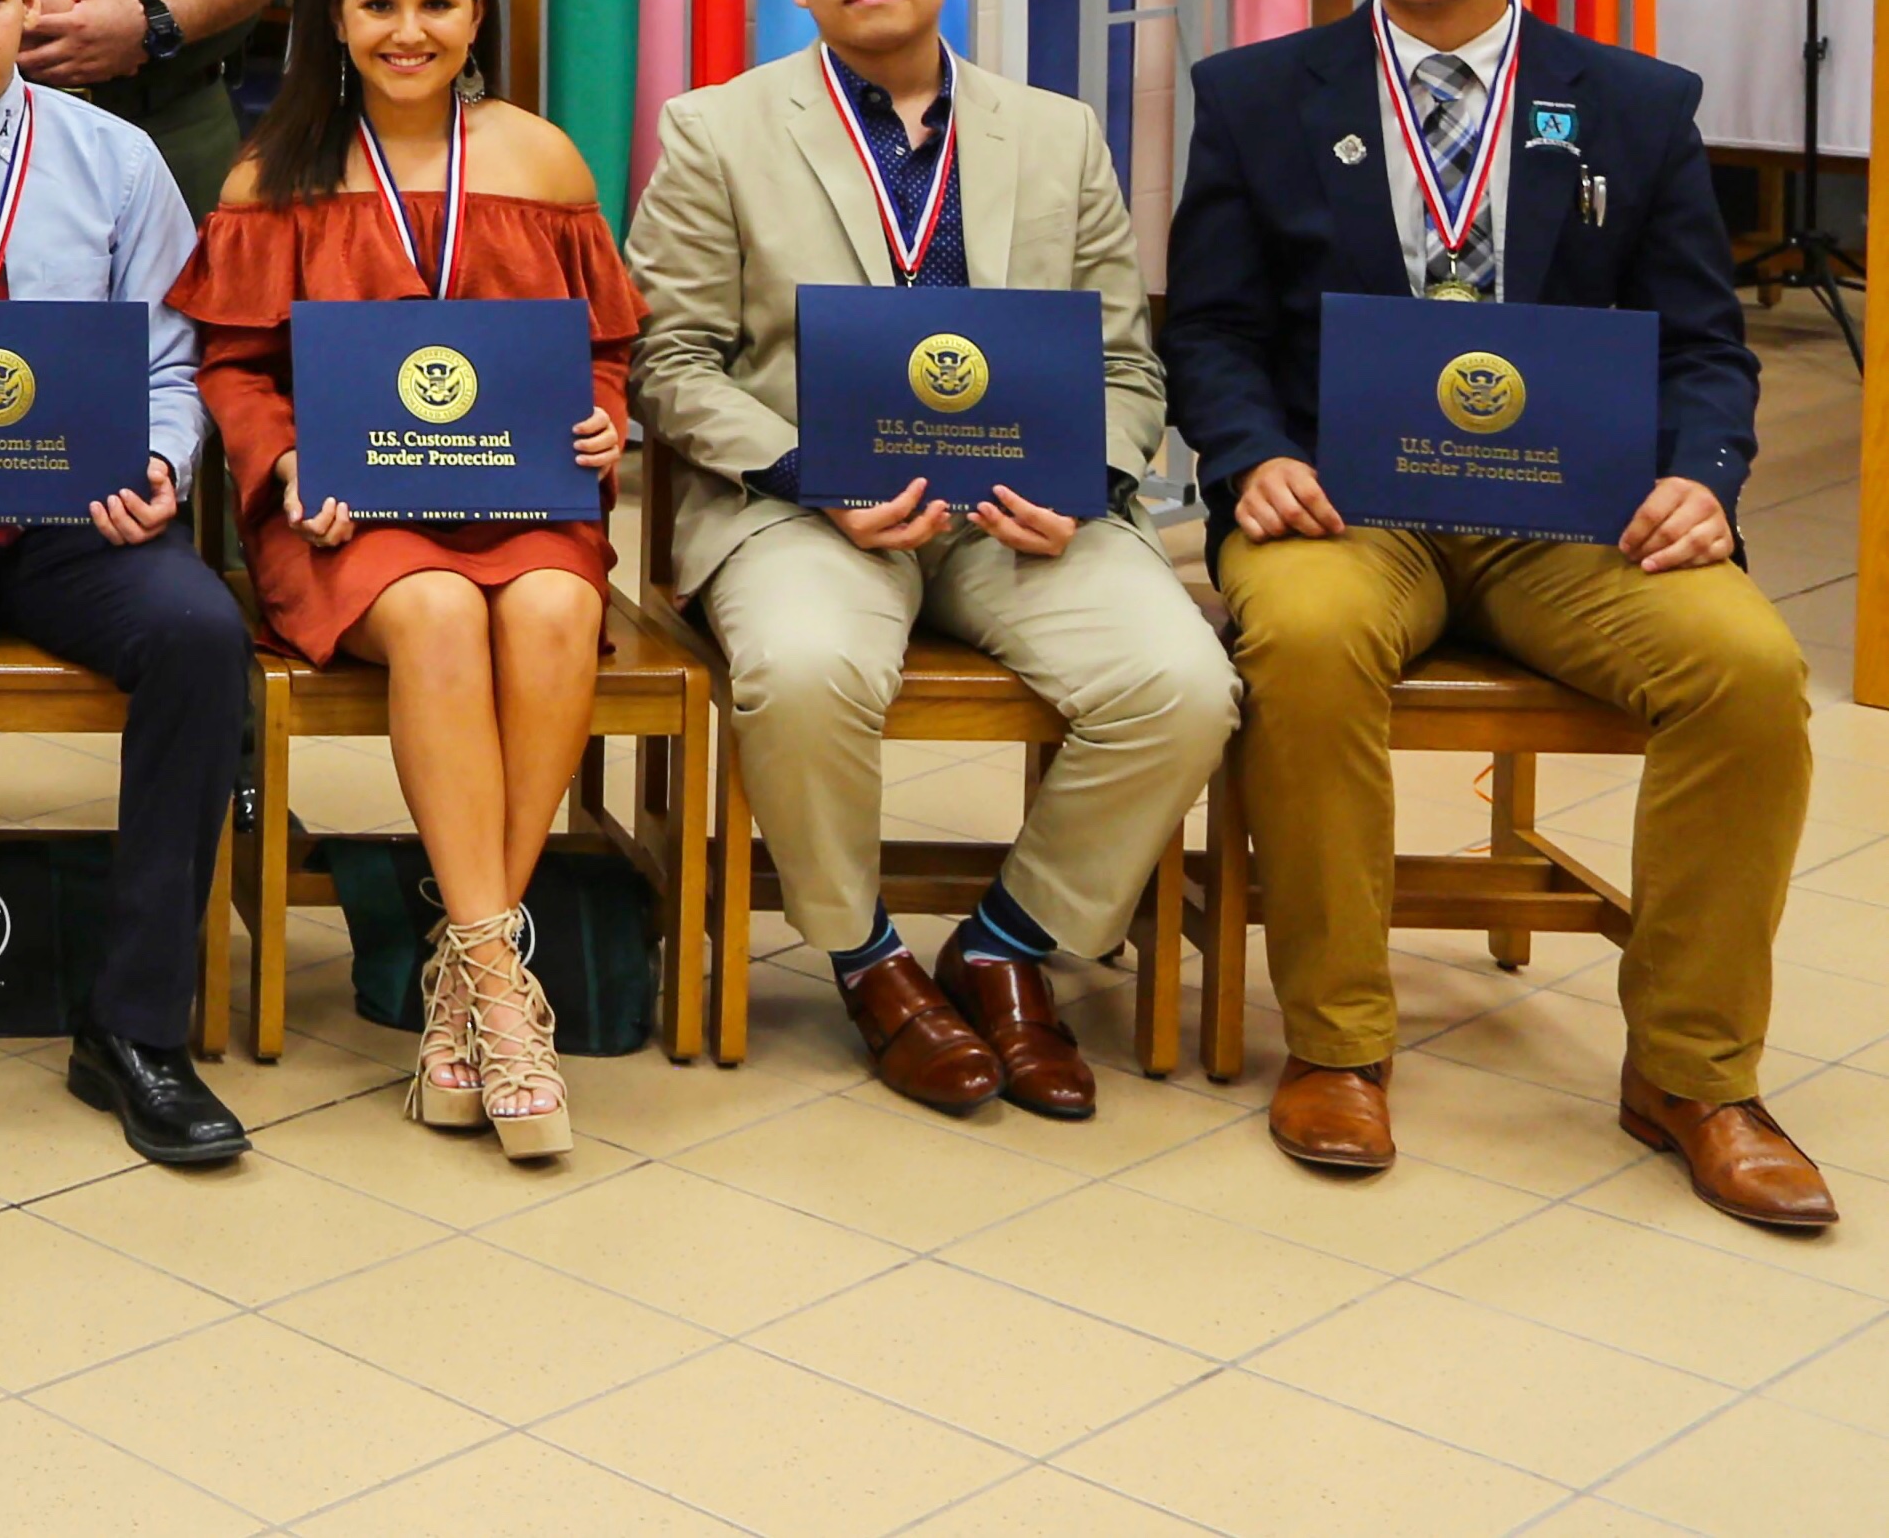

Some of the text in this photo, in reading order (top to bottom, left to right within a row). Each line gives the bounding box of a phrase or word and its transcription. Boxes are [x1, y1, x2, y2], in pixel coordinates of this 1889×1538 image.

[876, 419, 1020, 439] U.S. Customs and
[35, 436, 66, 451] and
[369, 431, 511, 447] U.S. Customs and
[873, 438, 1025, 458] Border Protection
[366, 450, 516, 466] Border Protection
